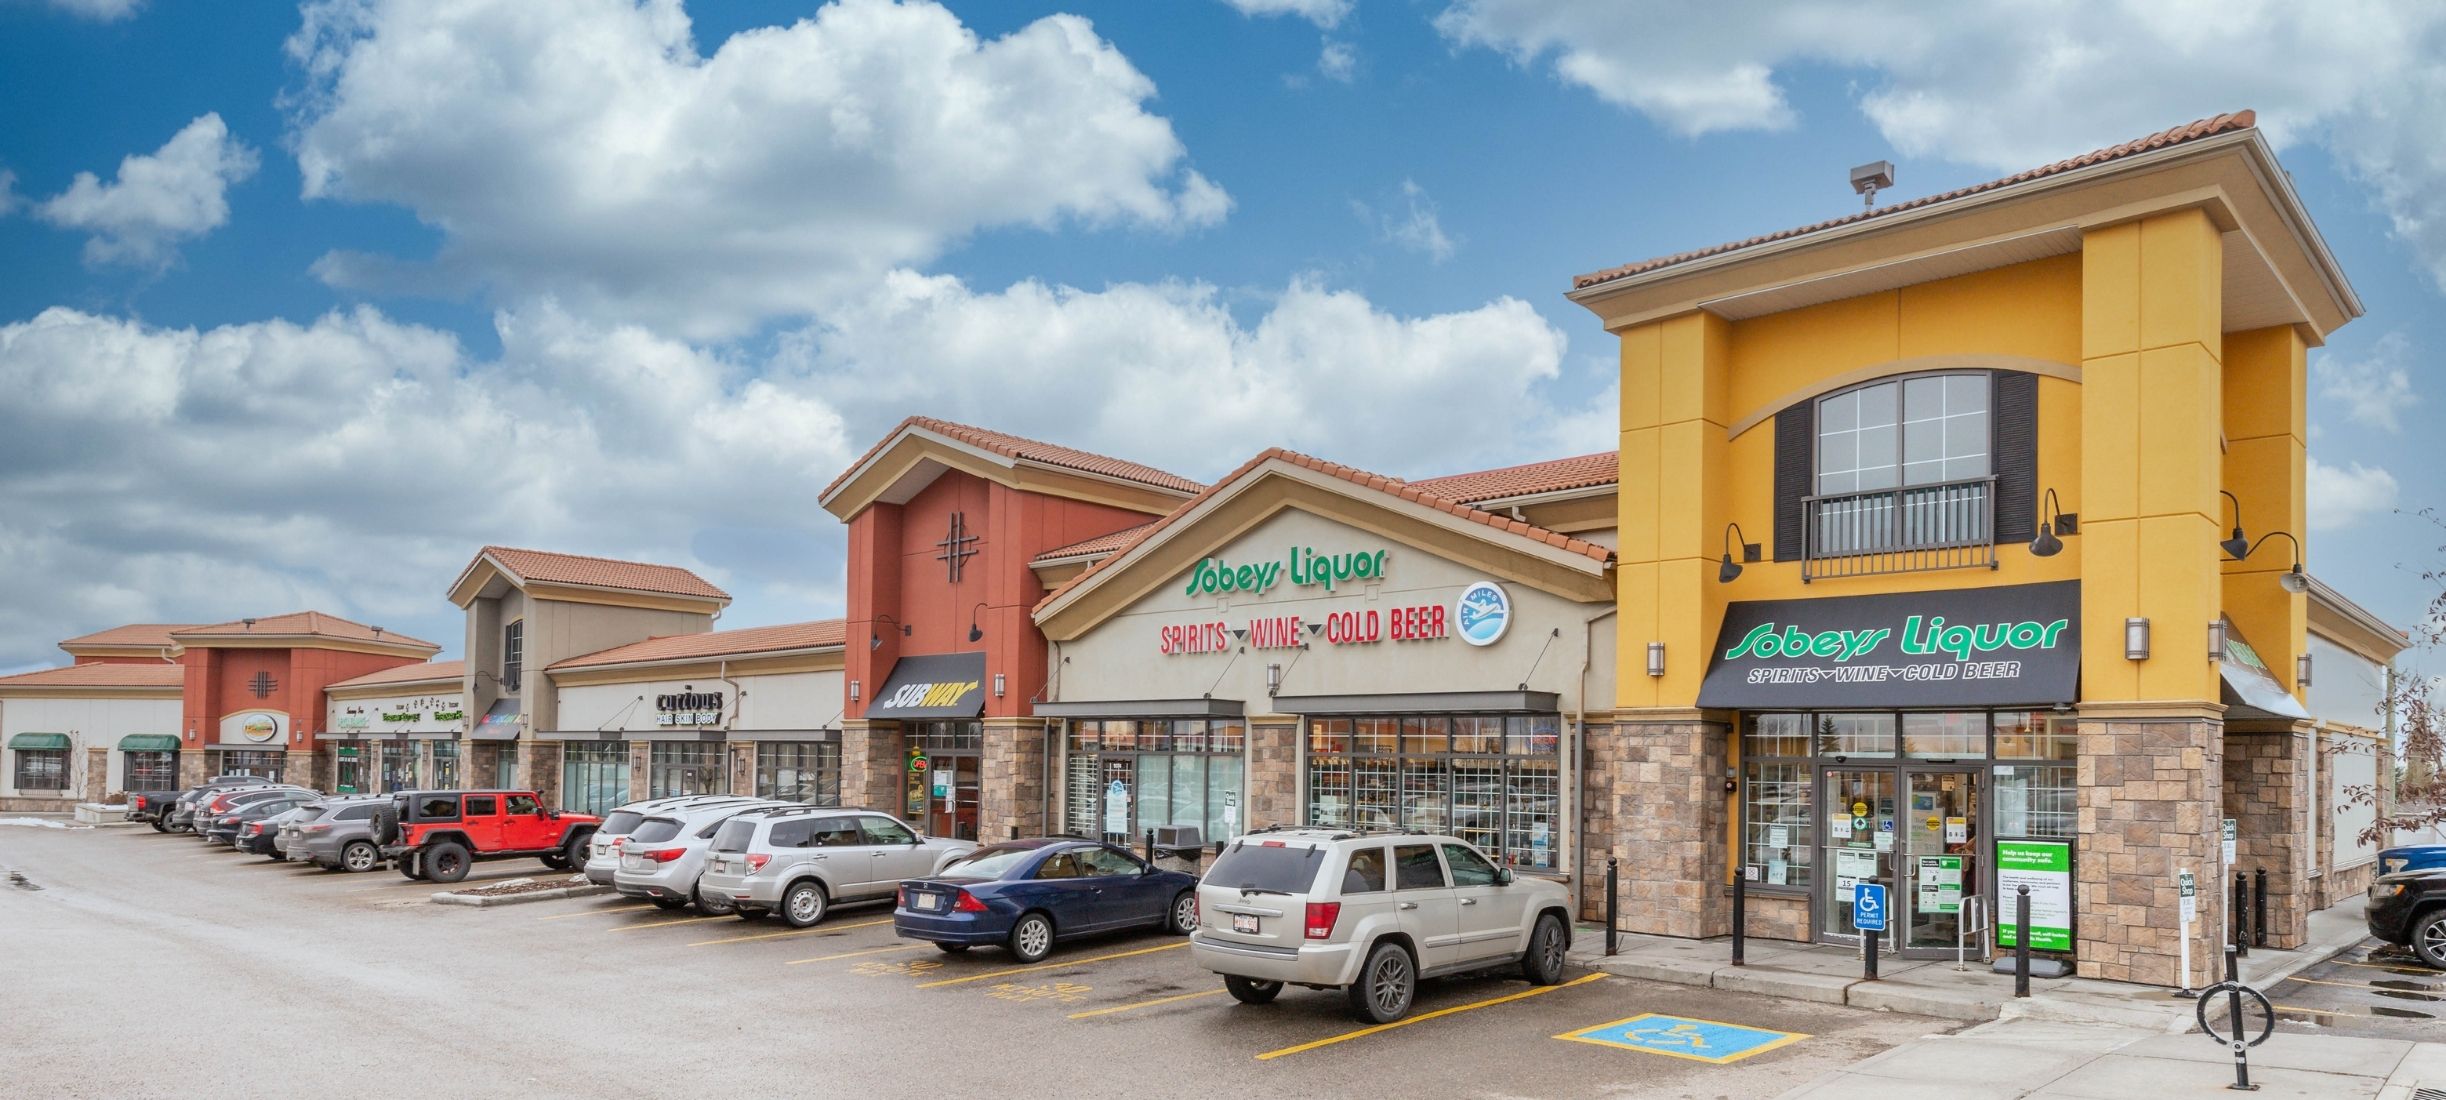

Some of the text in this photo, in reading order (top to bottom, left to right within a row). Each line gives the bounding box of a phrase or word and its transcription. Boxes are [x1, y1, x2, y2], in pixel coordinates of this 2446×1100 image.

[1186, 546, 1386, 596] Sobeys Liquor
[1462, 589, 1498, 625] AIR MILES
[1160, 604, 1446, 655] SPIRITS WINE COLD BEER
[1725, 615, 2069, 662] Sobeys Liquor
[1747, 661, 2022, 684] SPIRITS WINE COLD BEER
[883, 680, 979, 709] SUBWAY
[656, 712, 718, 725] HAIR SKIN BODY
[2025, 850, 2041, 858] keep
[2181, 877, 2194, 887] Quick
[2182, 886, 2194, 896] Shop
[1856, 918, 1883, 926] REQUIRED
